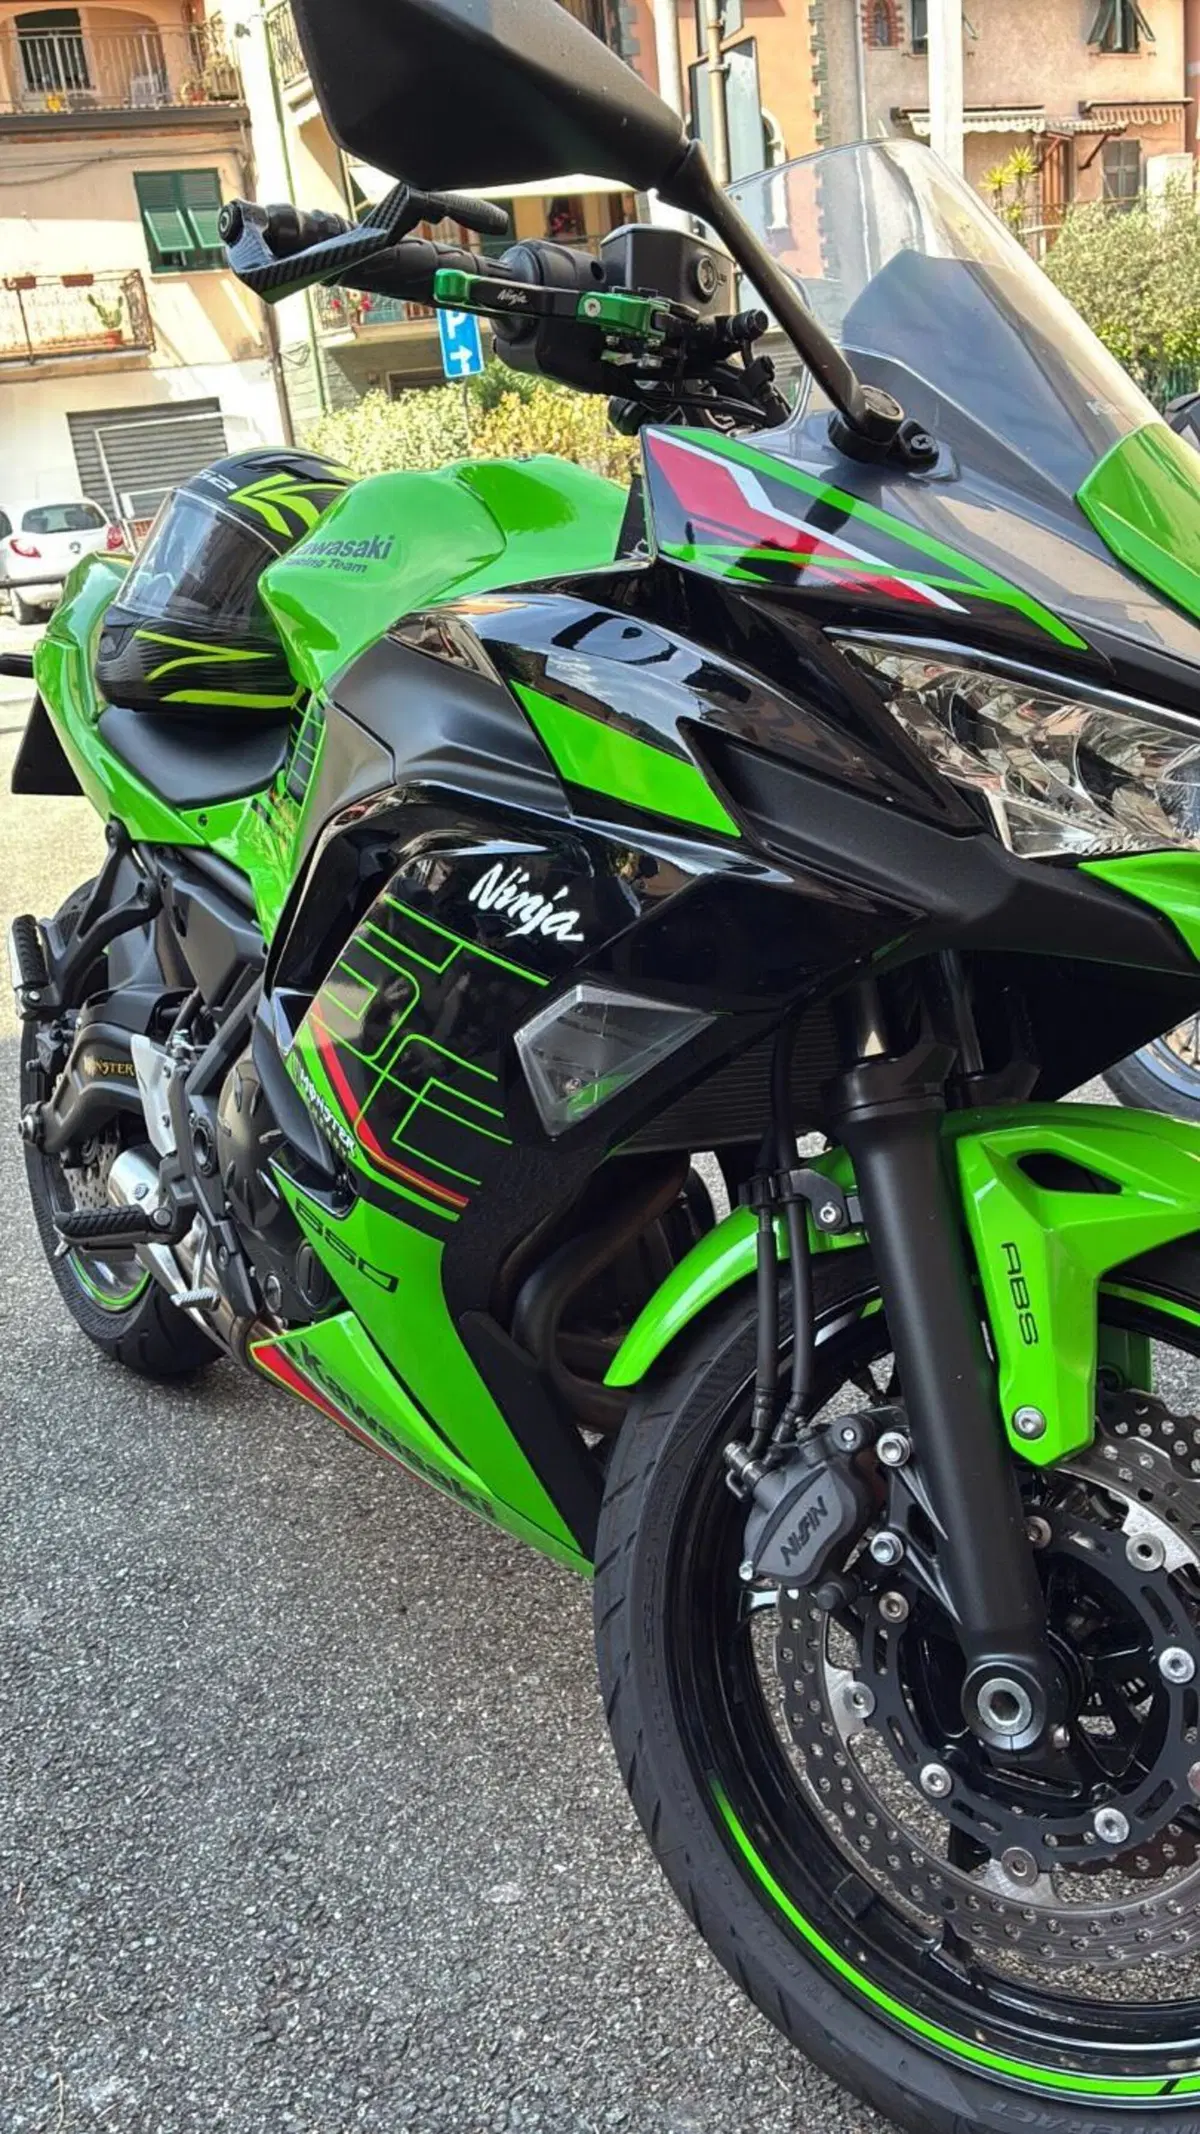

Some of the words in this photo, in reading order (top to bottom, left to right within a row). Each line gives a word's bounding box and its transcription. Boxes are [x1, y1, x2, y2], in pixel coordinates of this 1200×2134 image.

[446, 310, 466, 339] P
[497, 289, 528, 306] Ninja
[327, 558, 368, 573] Team
[468, 862, 584, 941] Ninja
[295, 1197, 399, 1293] 650
[1001, 1242, 1039, 1345] ABS
